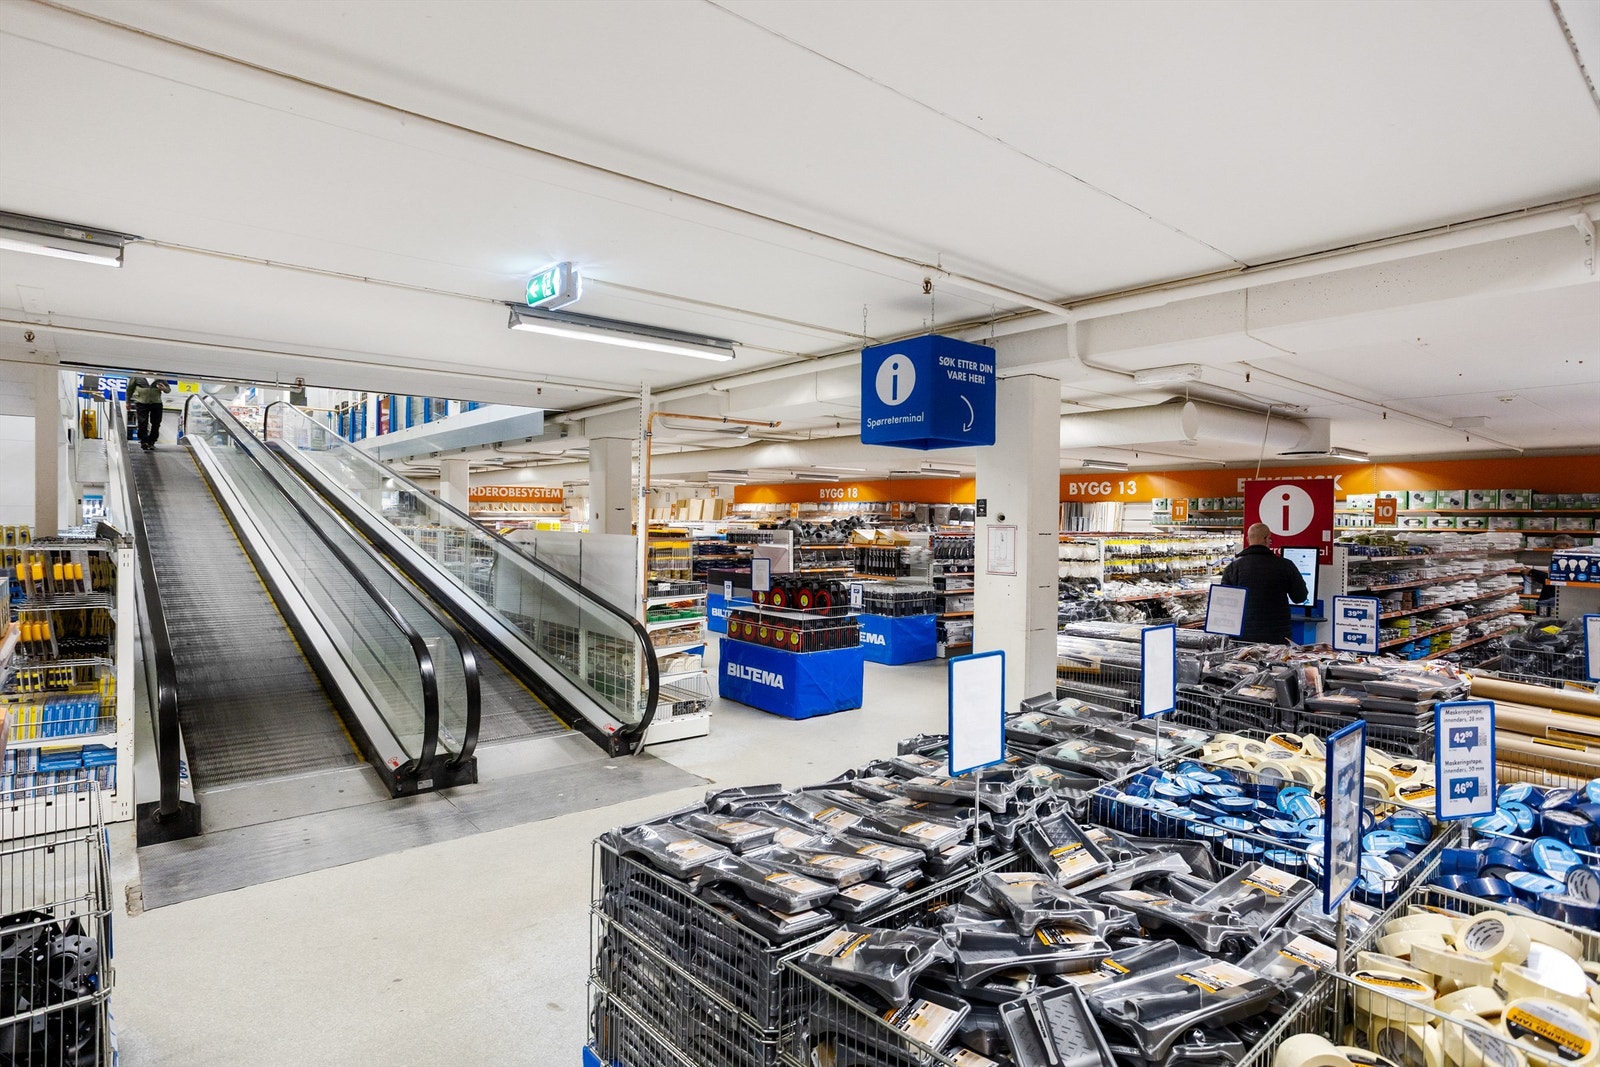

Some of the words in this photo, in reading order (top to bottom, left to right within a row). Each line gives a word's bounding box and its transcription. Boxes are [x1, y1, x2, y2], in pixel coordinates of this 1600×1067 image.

[938, 355, 956, 368] SØK
[957, 359, 978, 371] ETTER
[979, 363, 993, 374] DIN
[77, 375, 127, 392] KSSE
[947, 370, 967, 382] VARE
[968, 374, 986, 384] HER!
[866, 411, 925, 429] Spørreterminal
[469, 487, 561, 498] RDEROBESYSTEM
[819, 488, 845, 499] BYGG
[847, 487, 858, 499] 18
[1069, 481, 1112, 496] BYGG
[1118, 480, 1137, 495] 13
[1175, 506, 1184, 516] 11
[1377, 505, 1394, 518] 10
[727, 661, 784, 690] BILTEMA
[1535, 1025, 1584, 1050] MASKING
